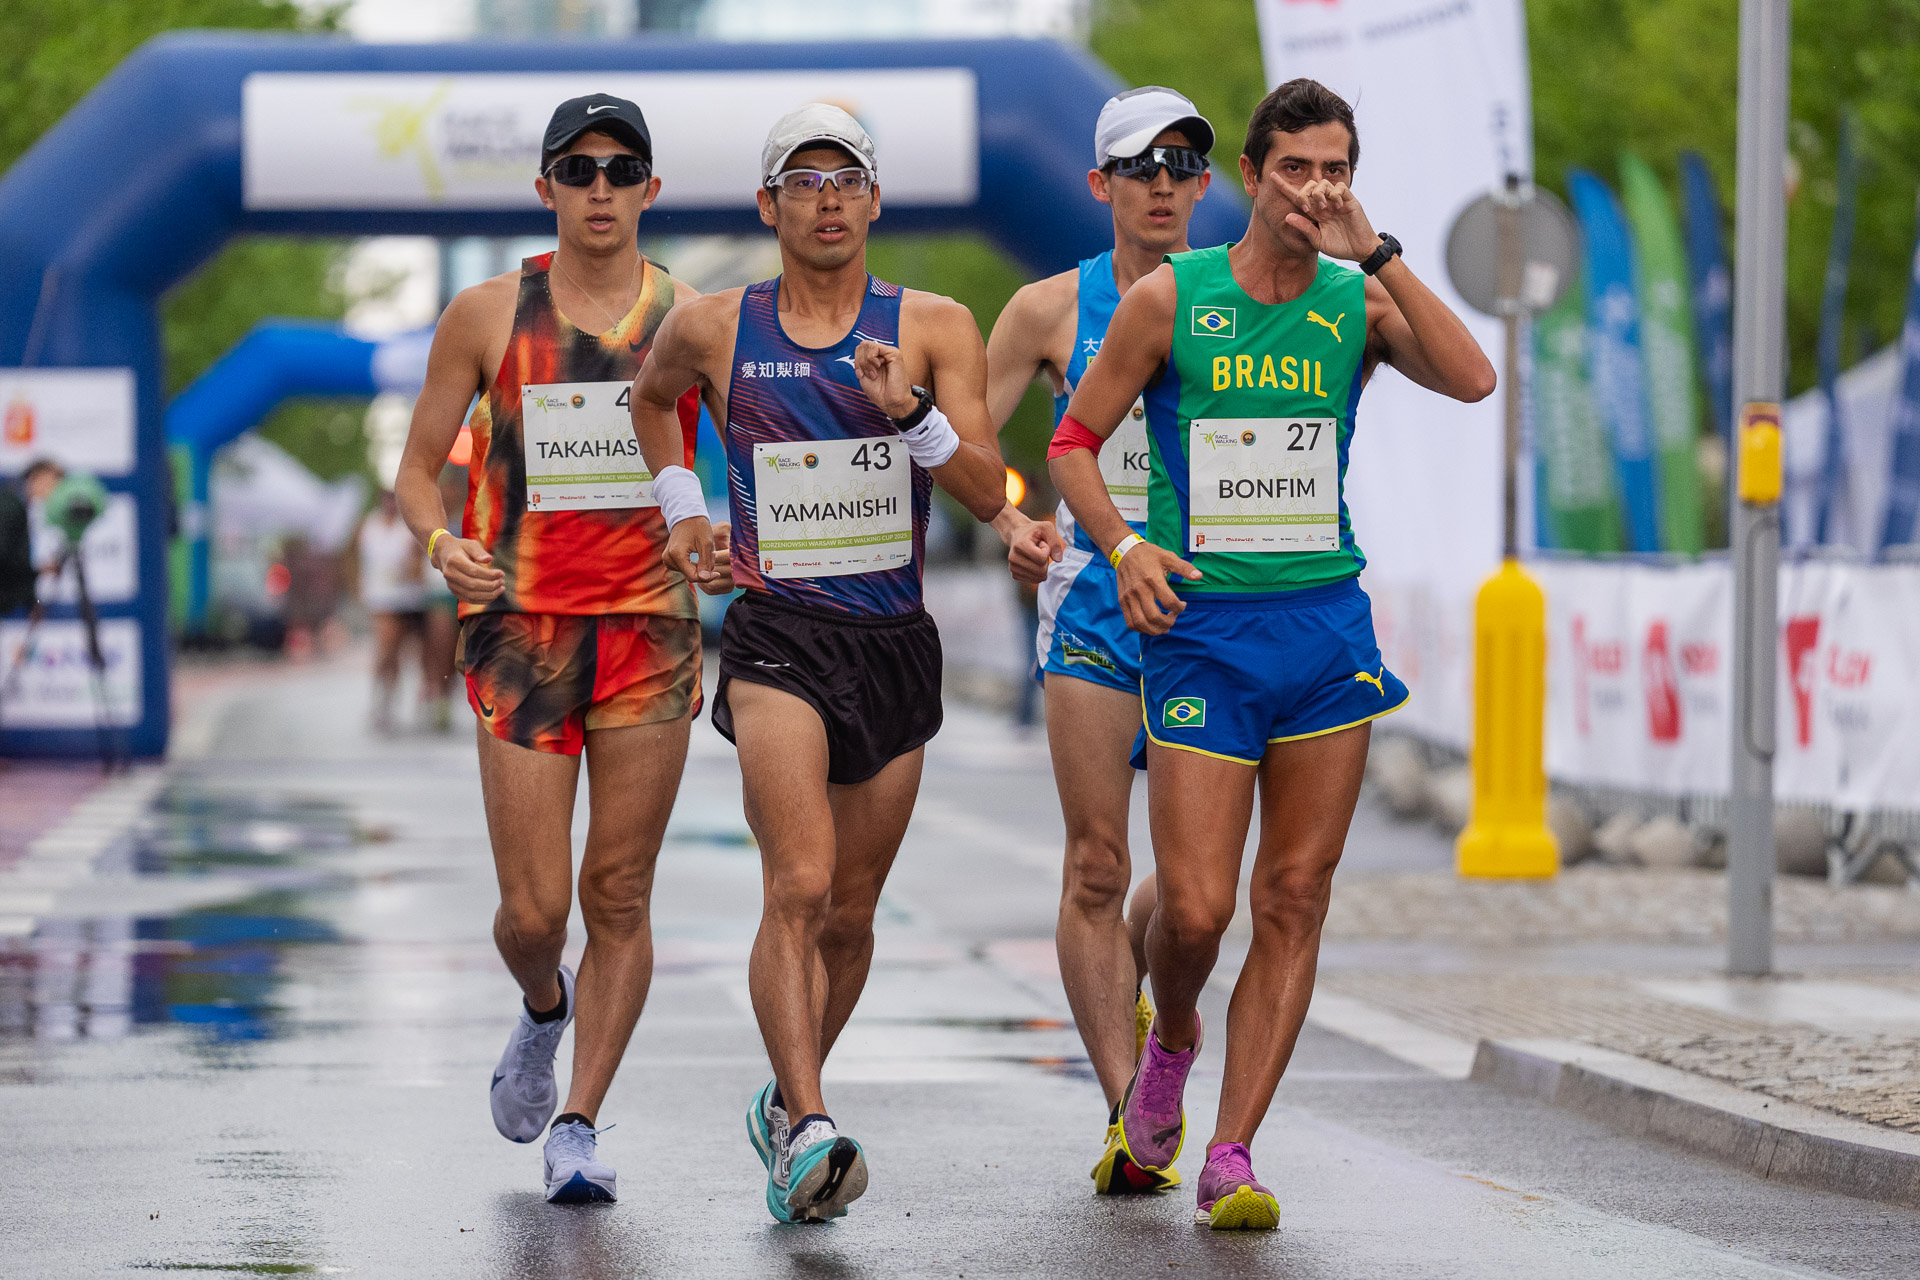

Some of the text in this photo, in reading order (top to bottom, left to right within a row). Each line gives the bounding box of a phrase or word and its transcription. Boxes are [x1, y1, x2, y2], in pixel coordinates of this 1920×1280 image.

[741, 361, 811, 378] 愛知製鋼
[1213, 354, 1328, 398] BRASIL
[536, 438, 642, 459] TAKAHAS
[1287, 422, 1322, 451] 27
[850, 441, 893, 472] 43
[1219, 478, 1315, 498] BONFIM
[769, 496, 897, 523] YAMANISHI
[854, 536, 881, 544] WALKING
